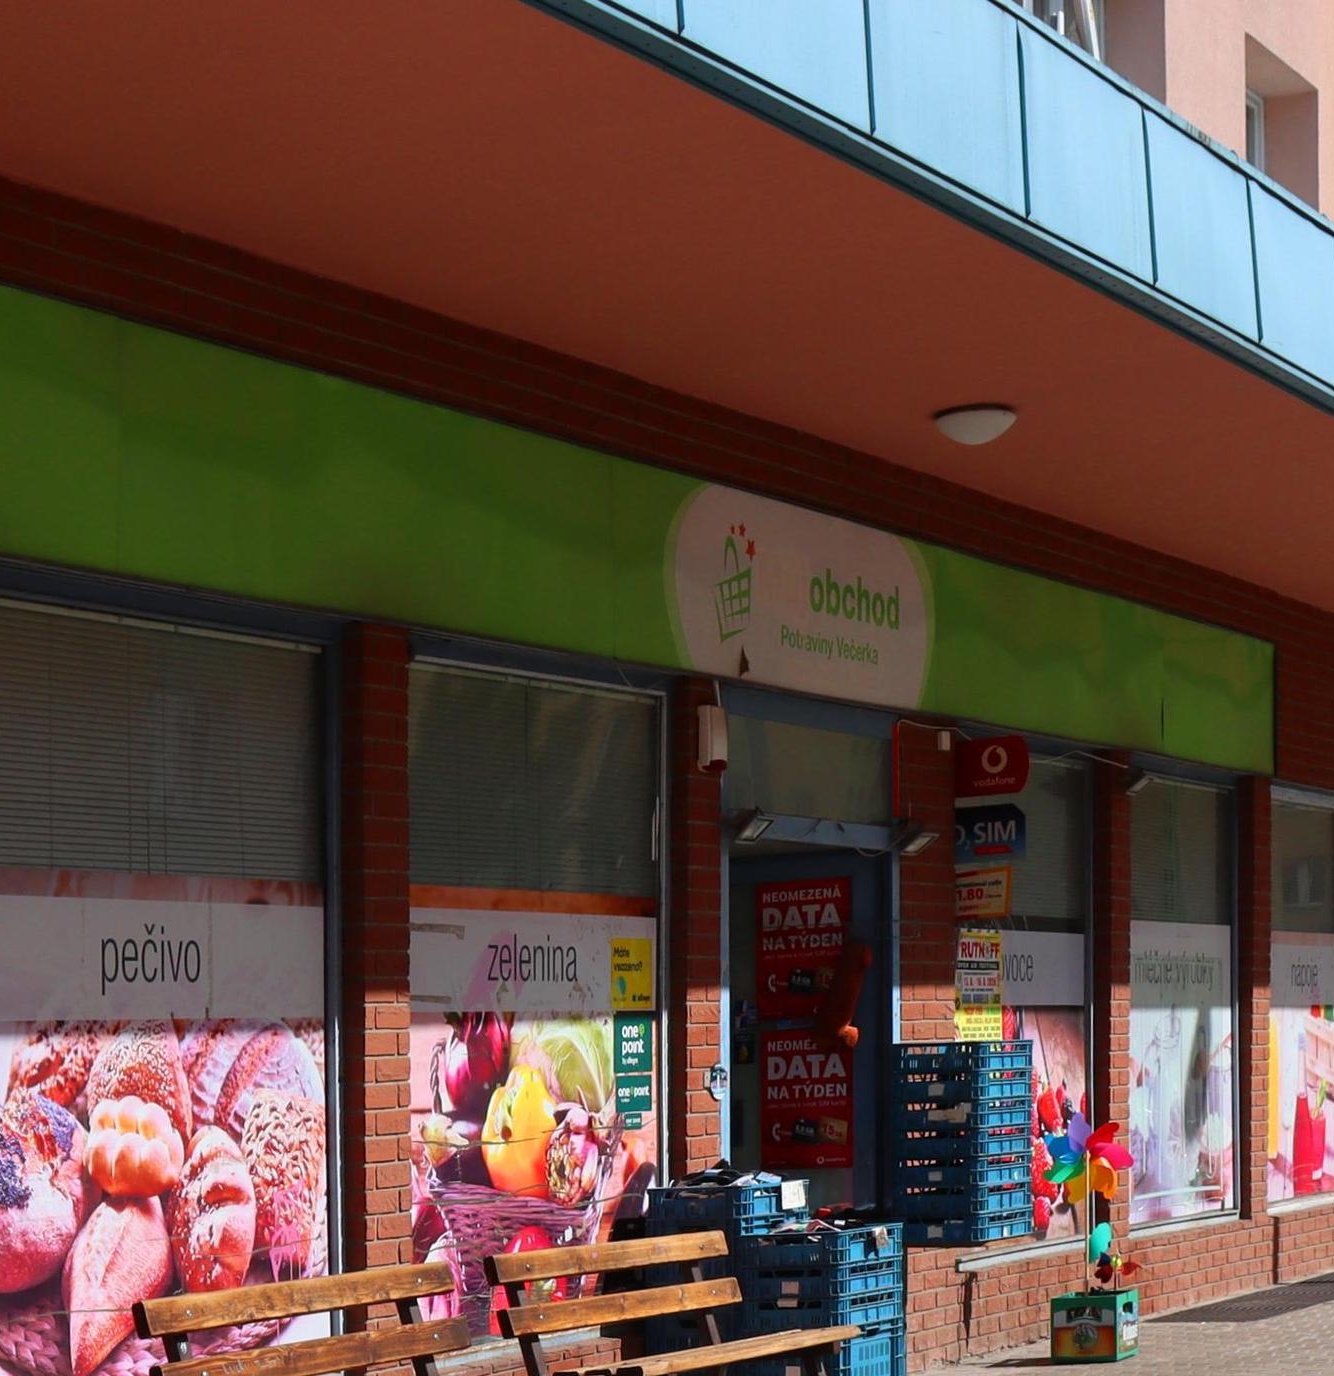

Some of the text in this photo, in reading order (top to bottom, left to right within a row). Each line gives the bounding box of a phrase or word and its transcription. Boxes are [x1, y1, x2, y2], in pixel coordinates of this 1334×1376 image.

[809, 567, 900, 631] obchod
[780, 624, 879, 665] Potraviny Večerka
[972, 775, 1017, 788] vodafone
[974, 819, 1017, 846] SIM
[762, 884, 842, 904] NEOMEZENÁ
[762, 903, 843, 932] DATA
[762, 931, 843, 951] NA TÝDEN
[100, 922, 202, 994] pečivo
[486, 932, 579, 984] zelenina
[1002, 953, 1034, 983] voce
[1290, 955, 1319, 993] nápoje
[621, 1025, 639, 1038] one
[621, 1039, 645, 1057] point
[767, 1039, 817, 1052] NEOME
[767, 1053, 847, 1081] DATA
[618, 1086, 630, 1098] one
[633, 1084, 650, 1101] point
[767, 1081, 847, 1100] NA TÝDEN
